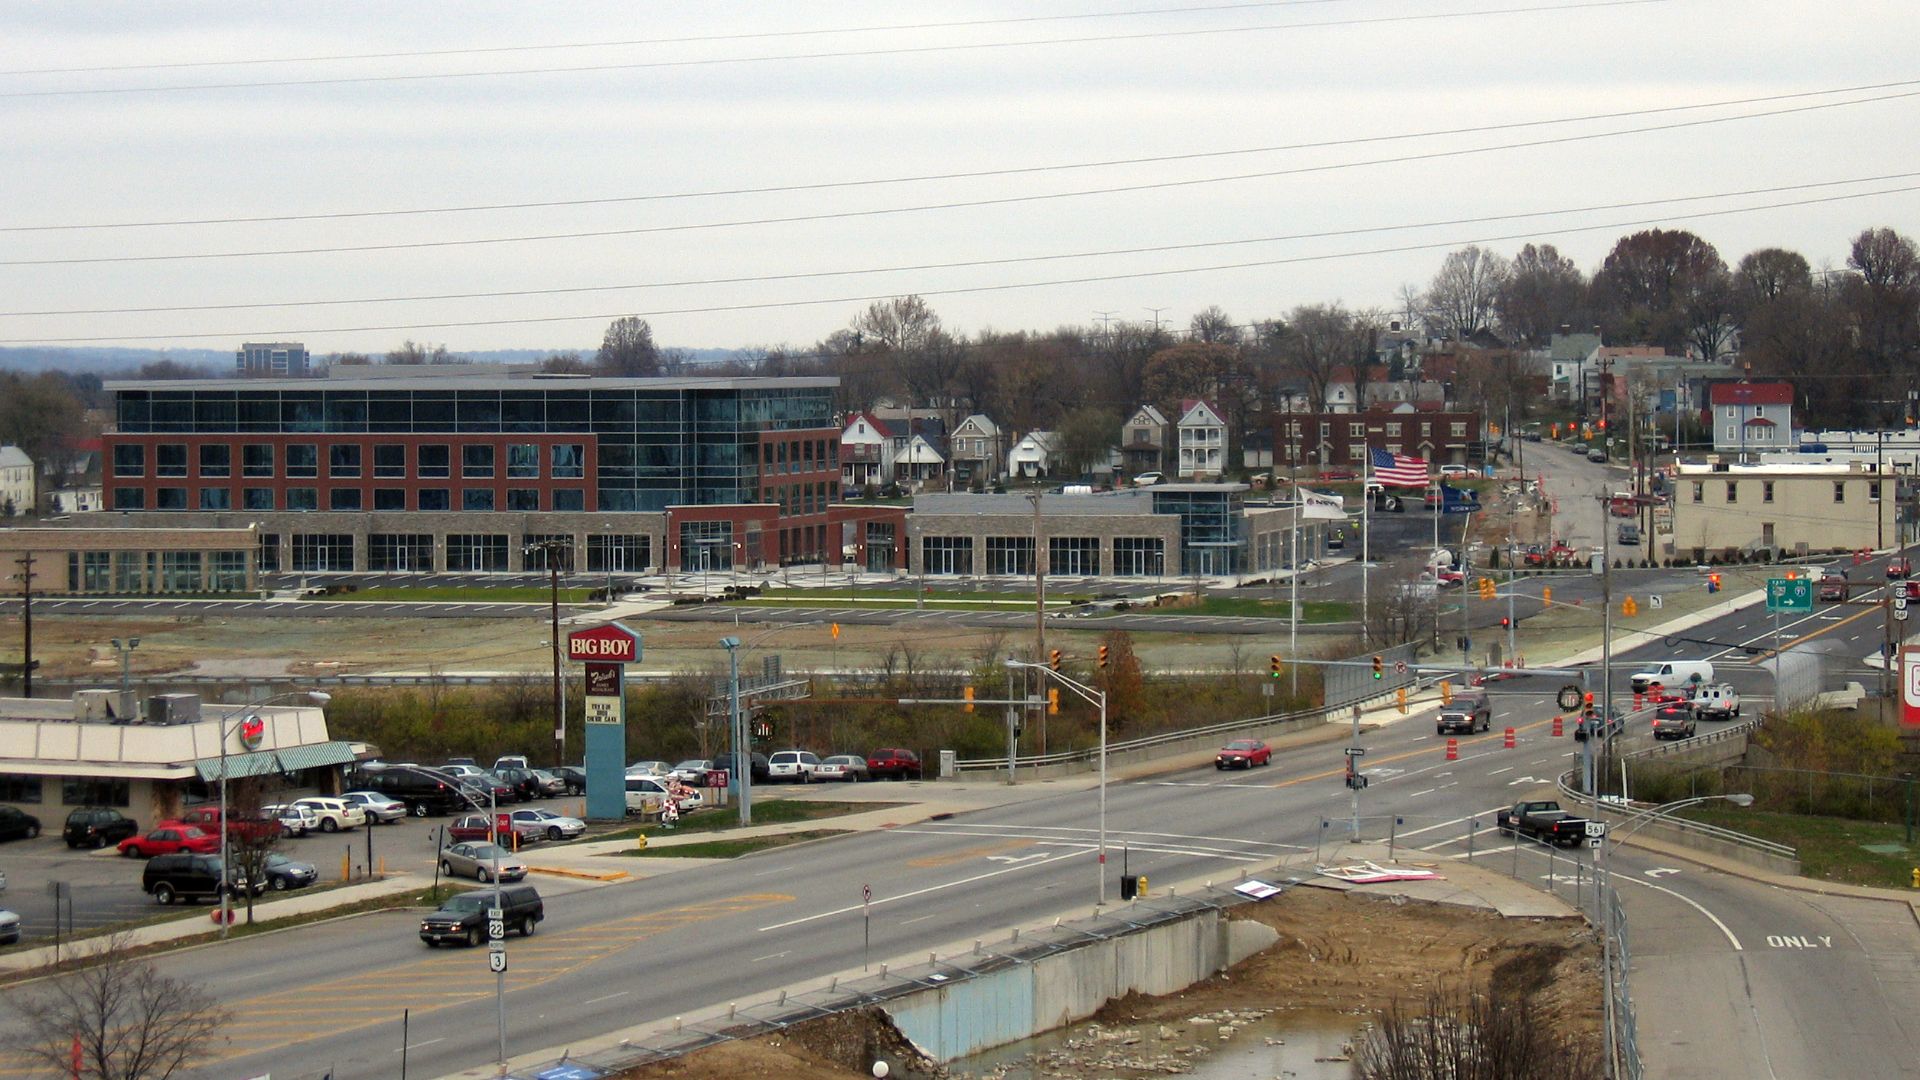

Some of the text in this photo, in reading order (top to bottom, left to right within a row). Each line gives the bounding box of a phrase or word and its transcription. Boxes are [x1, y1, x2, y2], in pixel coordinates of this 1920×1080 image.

[571, 638, 632, 656] BIG BOY
[1587, 825, 1603, 834] 561
[491, 924, 502, 936] 22
[1766, 935, 1832, 948] ONLY
[495, 956, 501, 967] 3
